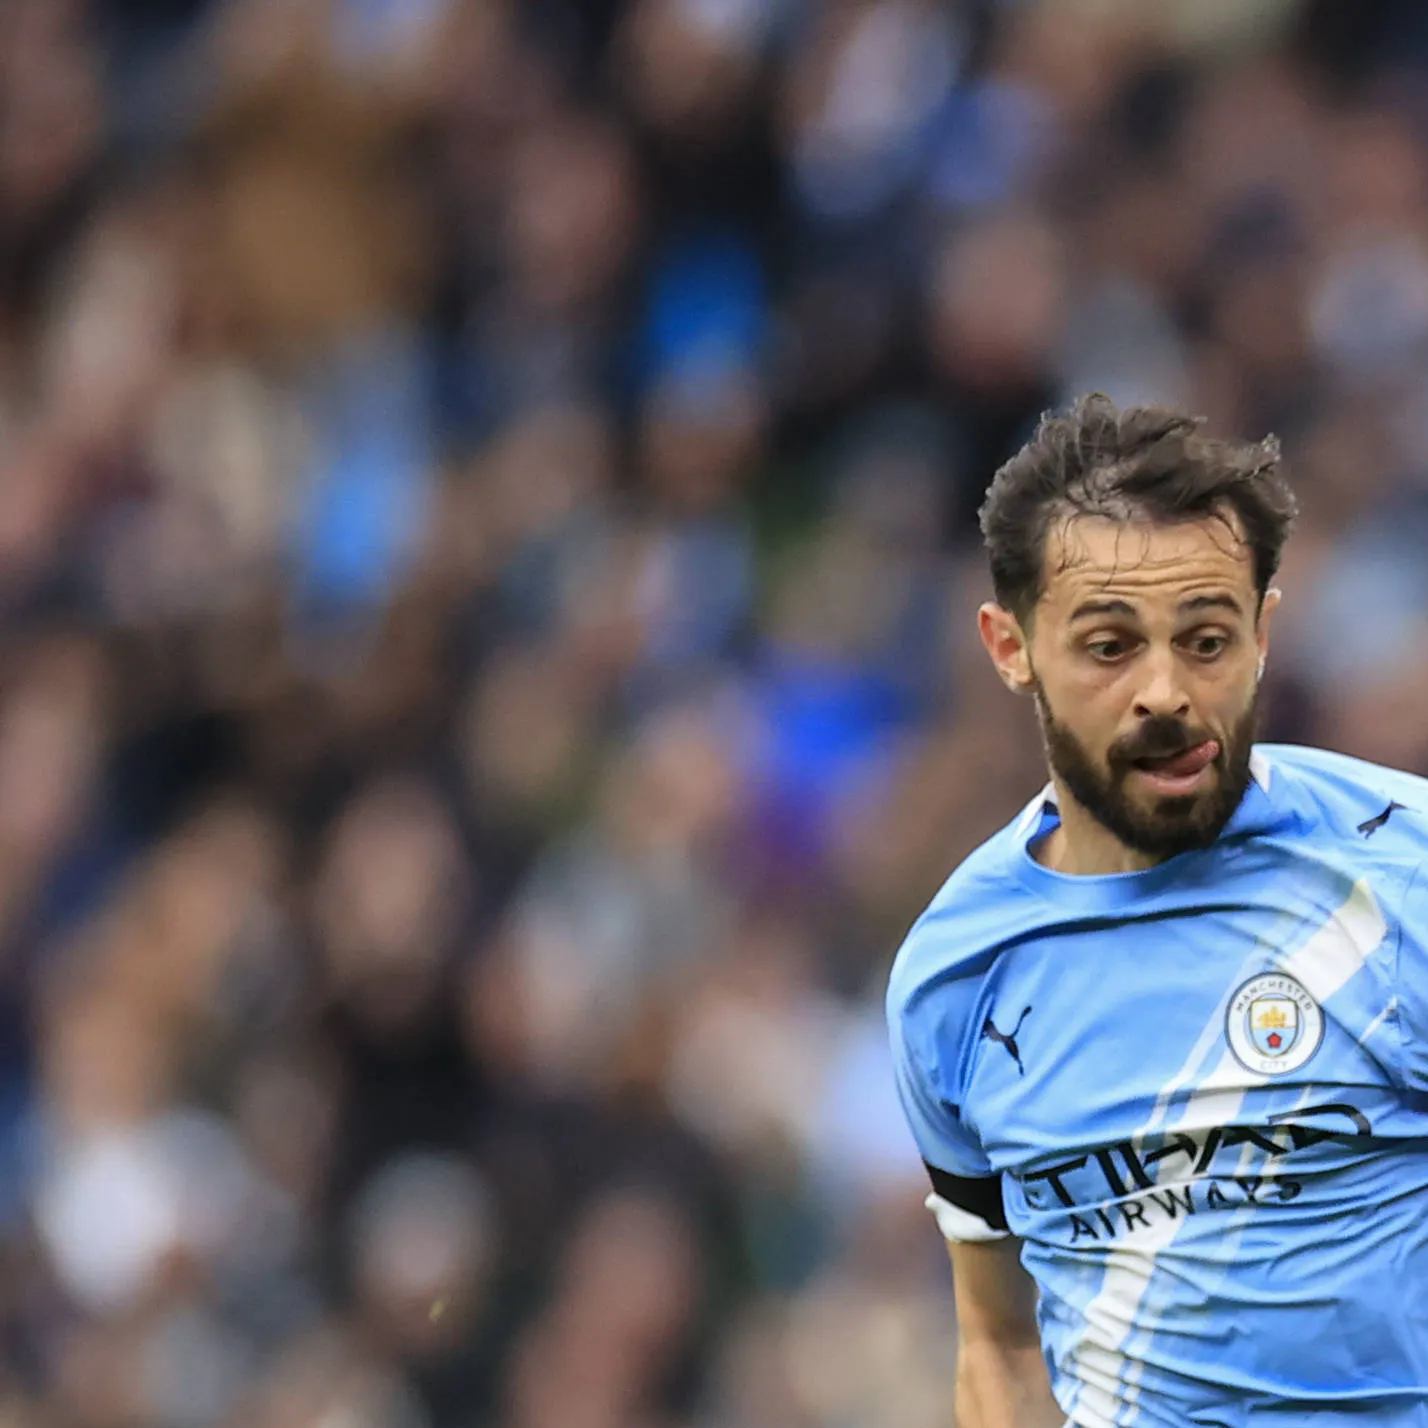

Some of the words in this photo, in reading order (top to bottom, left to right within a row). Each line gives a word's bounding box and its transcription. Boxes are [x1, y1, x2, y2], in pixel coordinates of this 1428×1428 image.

[1236, 980, 1313, 1012] MANCHESTER
[1260, 1060, 1288, 1071] CITY
[1069, 1174, 1303, 1243] AIRWAYS
